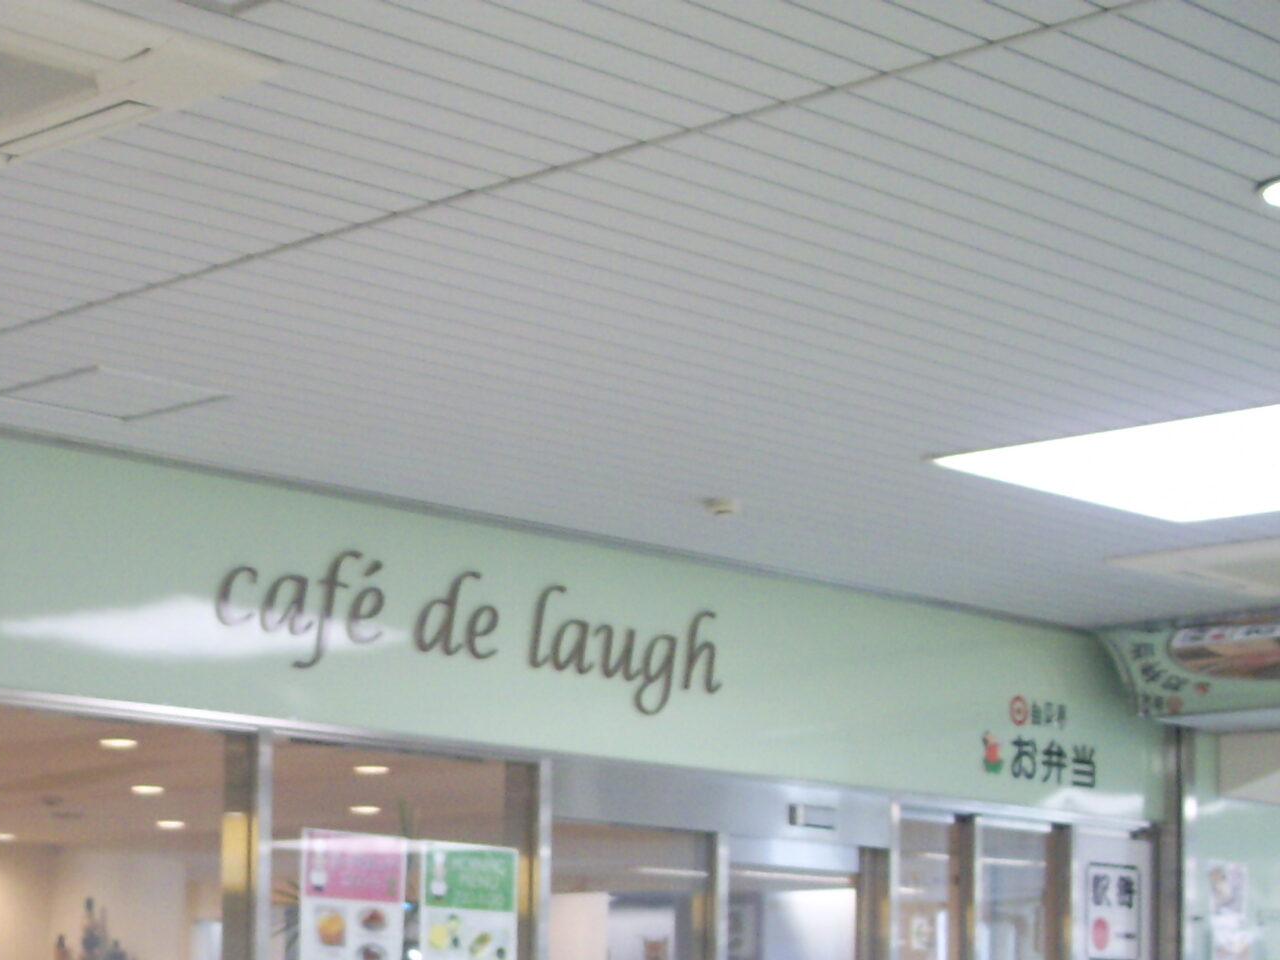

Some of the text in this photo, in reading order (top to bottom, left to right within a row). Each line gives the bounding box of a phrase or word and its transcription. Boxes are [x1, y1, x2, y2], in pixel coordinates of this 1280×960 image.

[214, 549, 722, 716] café de laugh
[1010, 734, 1096, 788] お弁当
